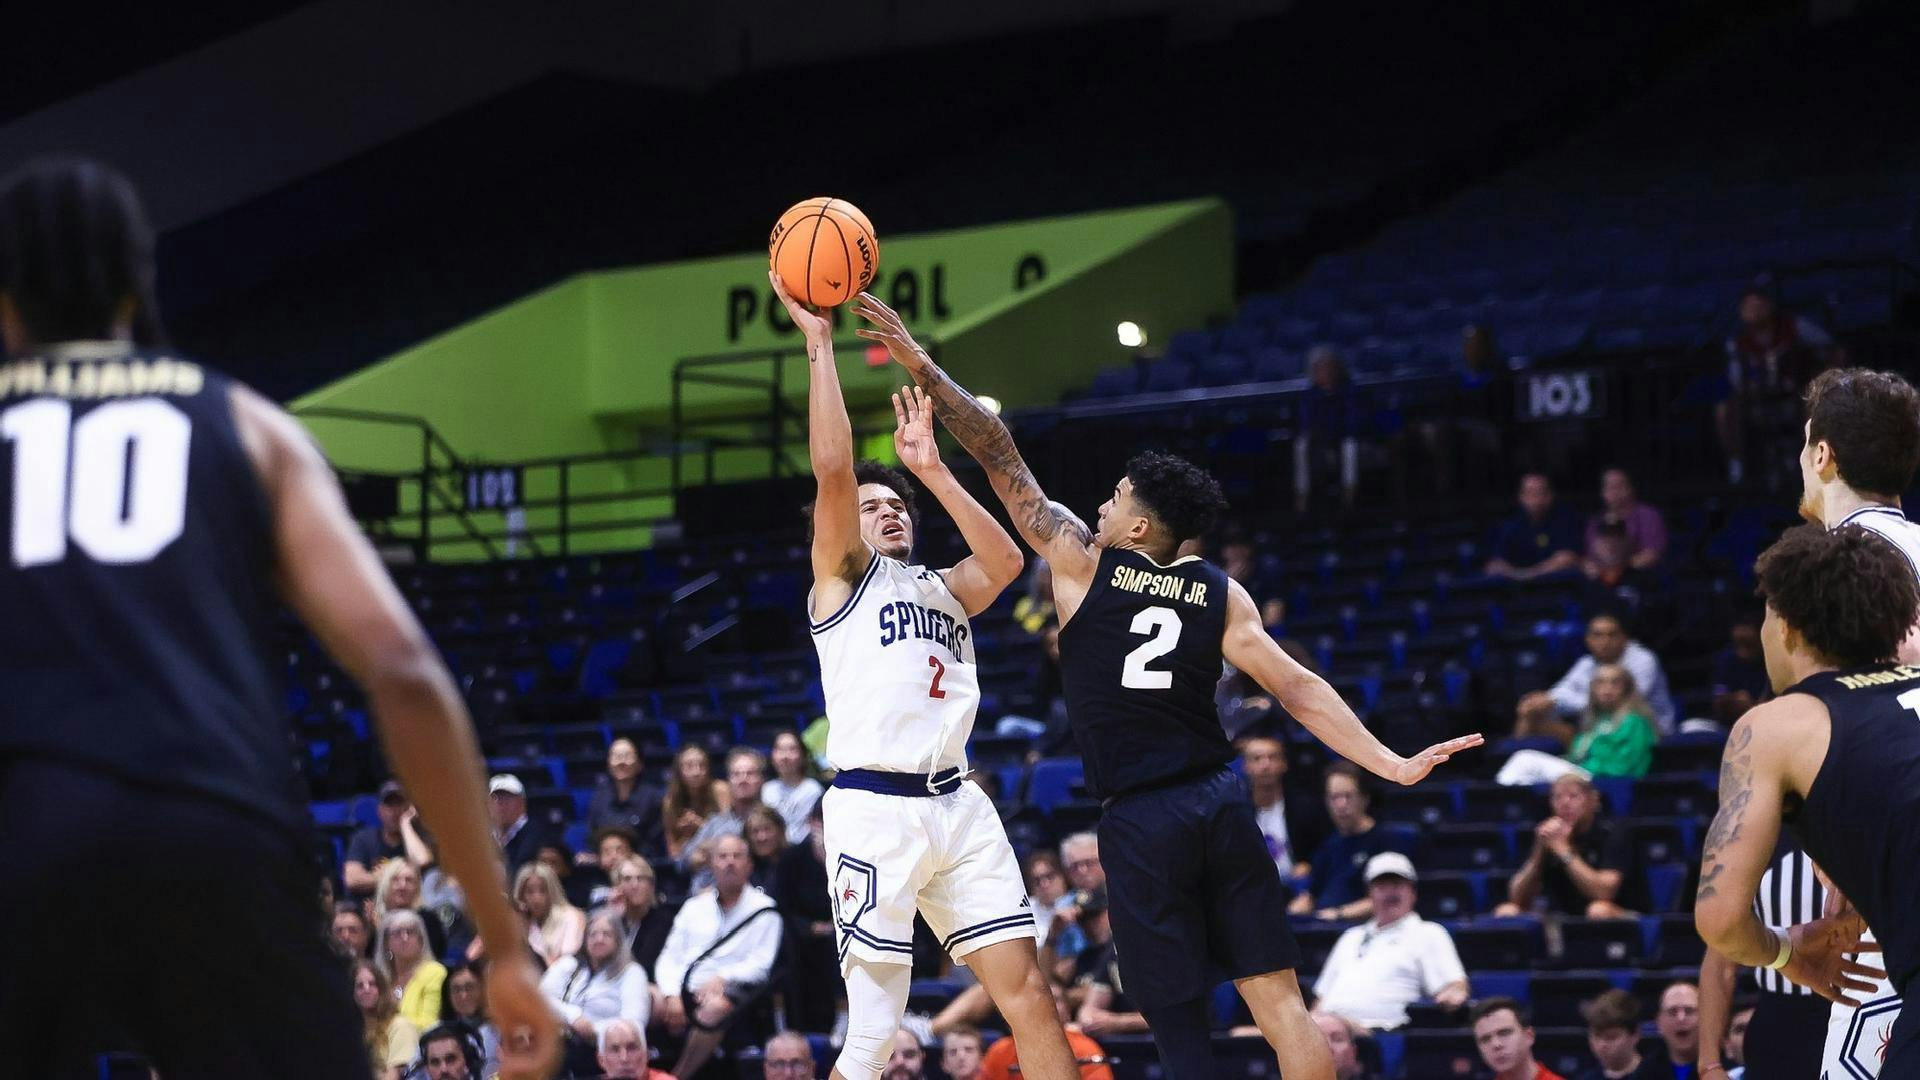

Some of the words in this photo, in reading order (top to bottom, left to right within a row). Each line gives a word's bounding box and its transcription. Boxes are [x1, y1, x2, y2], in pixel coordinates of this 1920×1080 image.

[0, 397, 192, 568] 10
[1110, 565, 1185, 600] SIMPSON
[1184, 581, 1208, 607] JR.
[879, 601, 968, 664] SPIDERS
[1121, 605, 1183, 689] 2
[928, 655, 946, 699] 2
